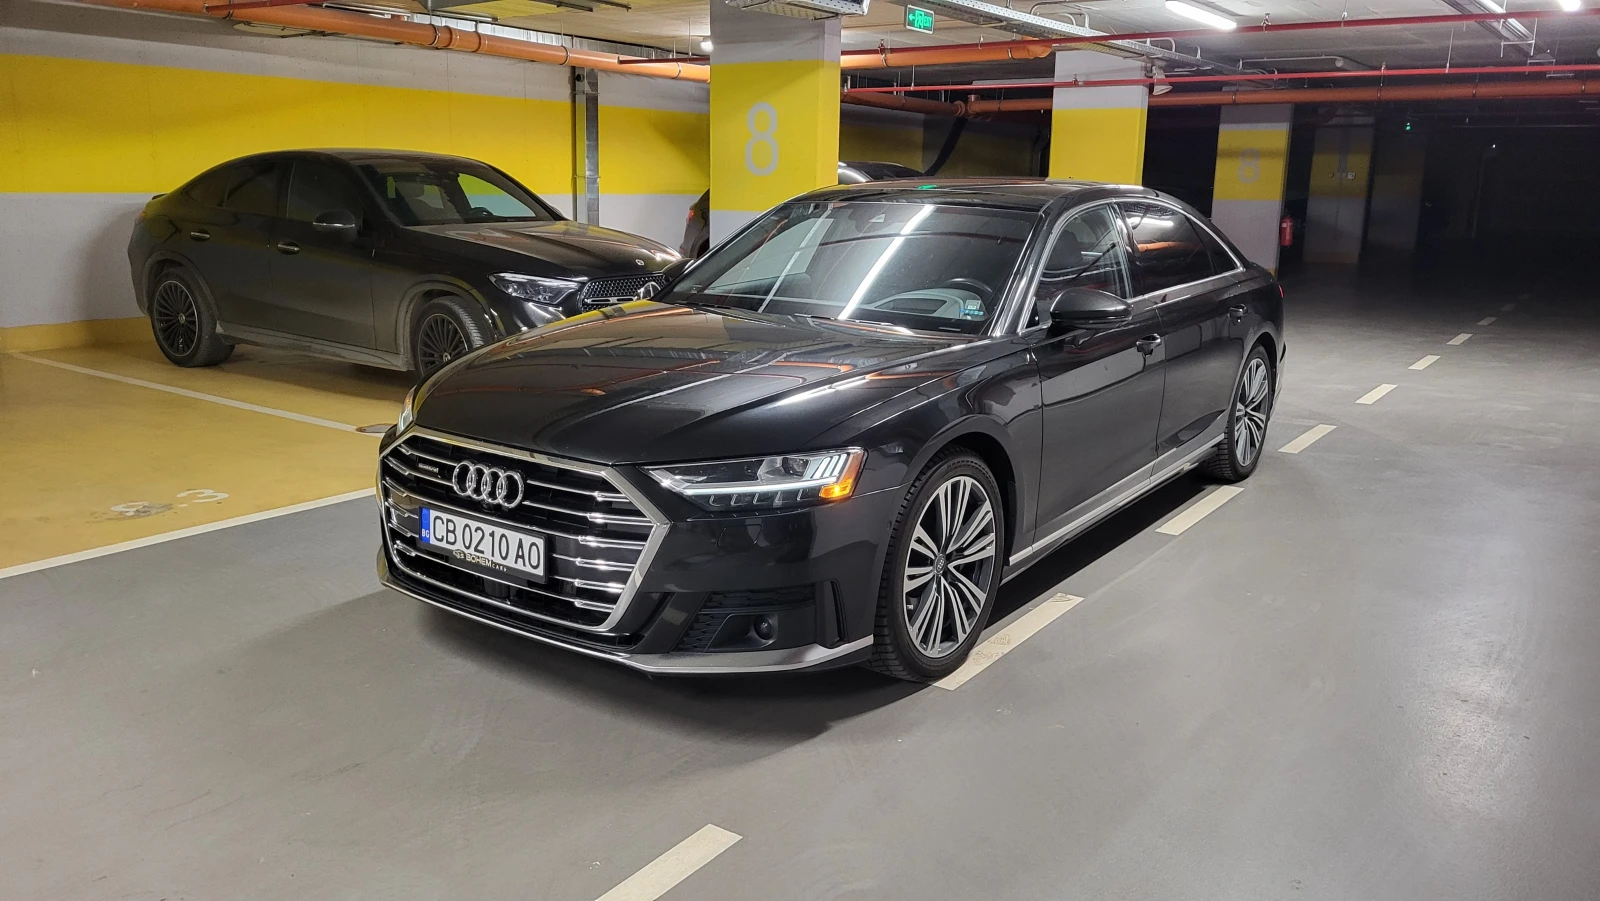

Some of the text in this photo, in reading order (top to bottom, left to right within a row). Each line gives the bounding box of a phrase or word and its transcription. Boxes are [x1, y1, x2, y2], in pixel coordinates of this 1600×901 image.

[744, 101, 779, 176] 8
[1238, 147, 1261, 184] 8
[421, 528, 430, 538] BG
[433, 515, 457, 546] CB
[462, 523, 510, 561] 0210
[465, 553, 492, 568] BOHEM
